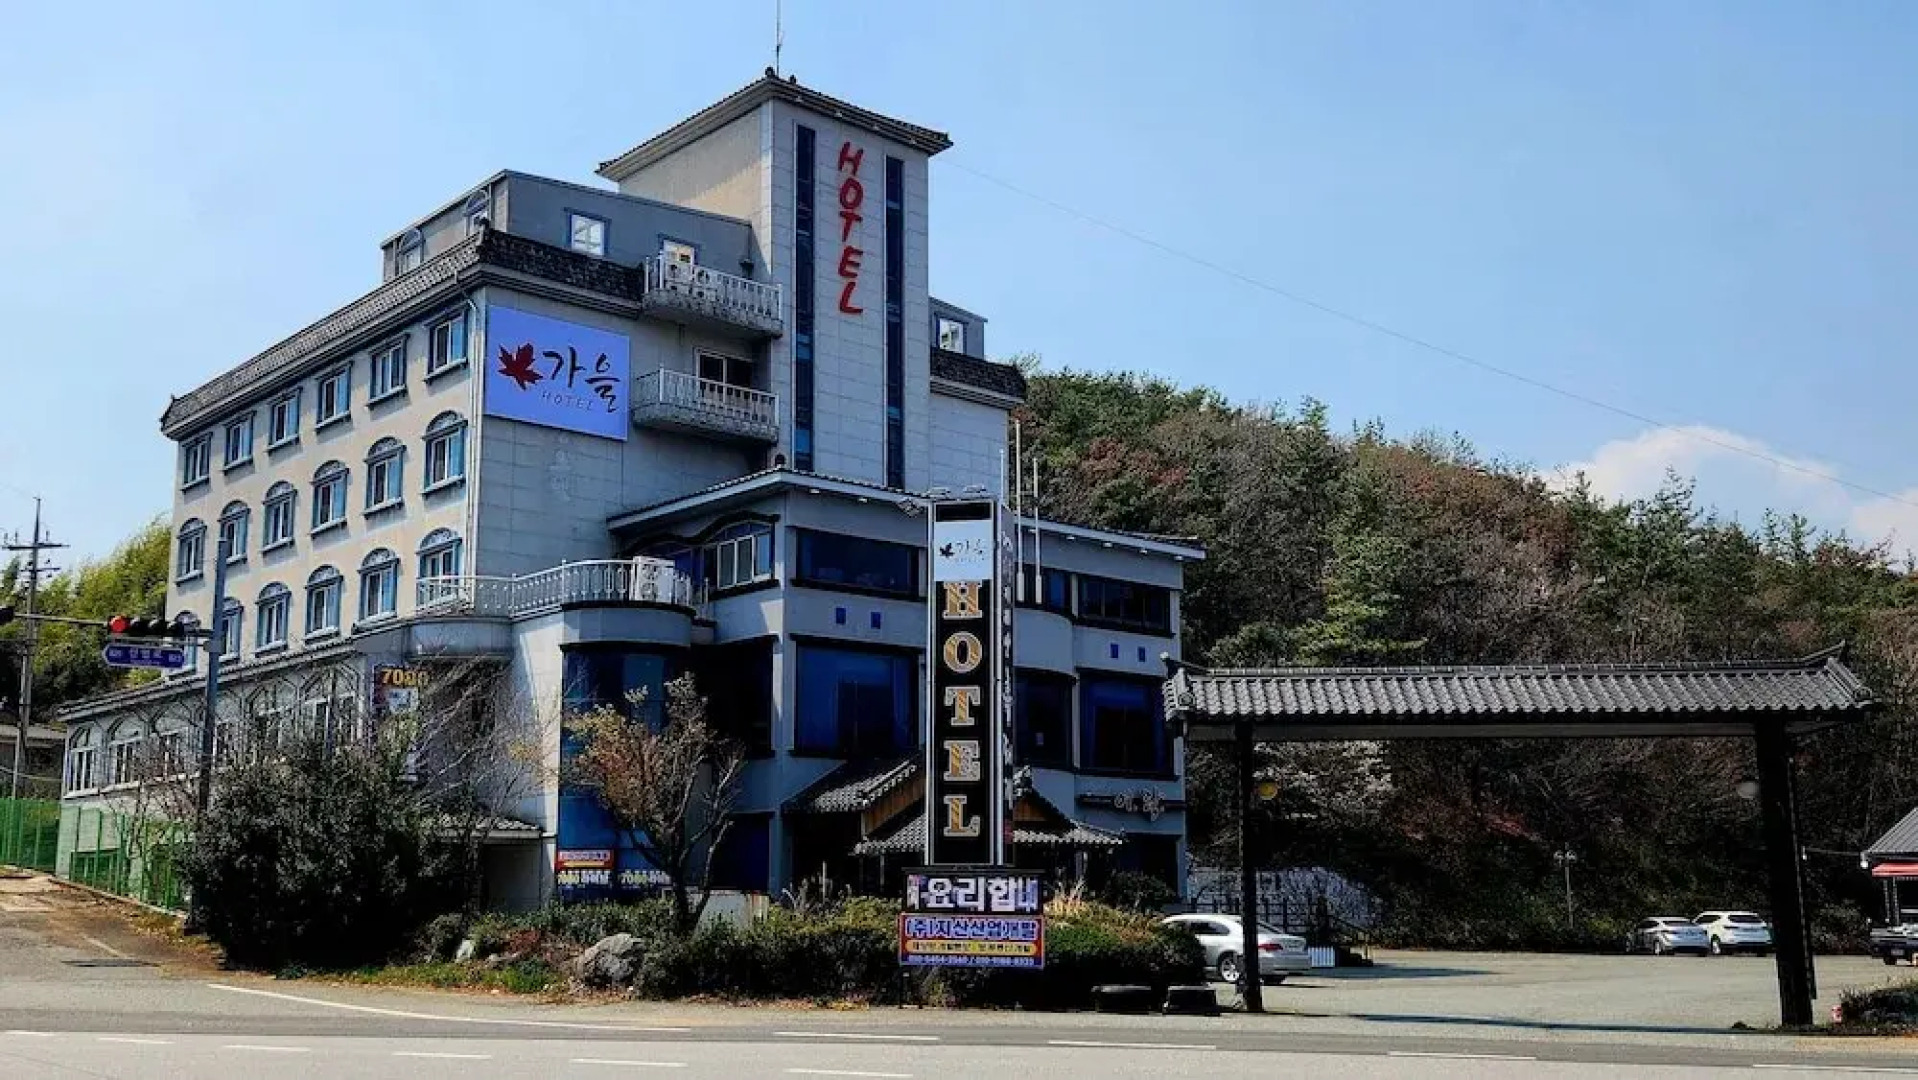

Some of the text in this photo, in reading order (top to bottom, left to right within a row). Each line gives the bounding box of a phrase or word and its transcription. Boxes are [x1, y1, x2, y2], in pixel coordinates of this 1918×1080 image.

[838, 141, 864, 314] HOTEL
[542, 345, 621, 413] 가을
[542, 390, 594, 412] HOTEL
[943, 582, 983, 837] HOTEL
